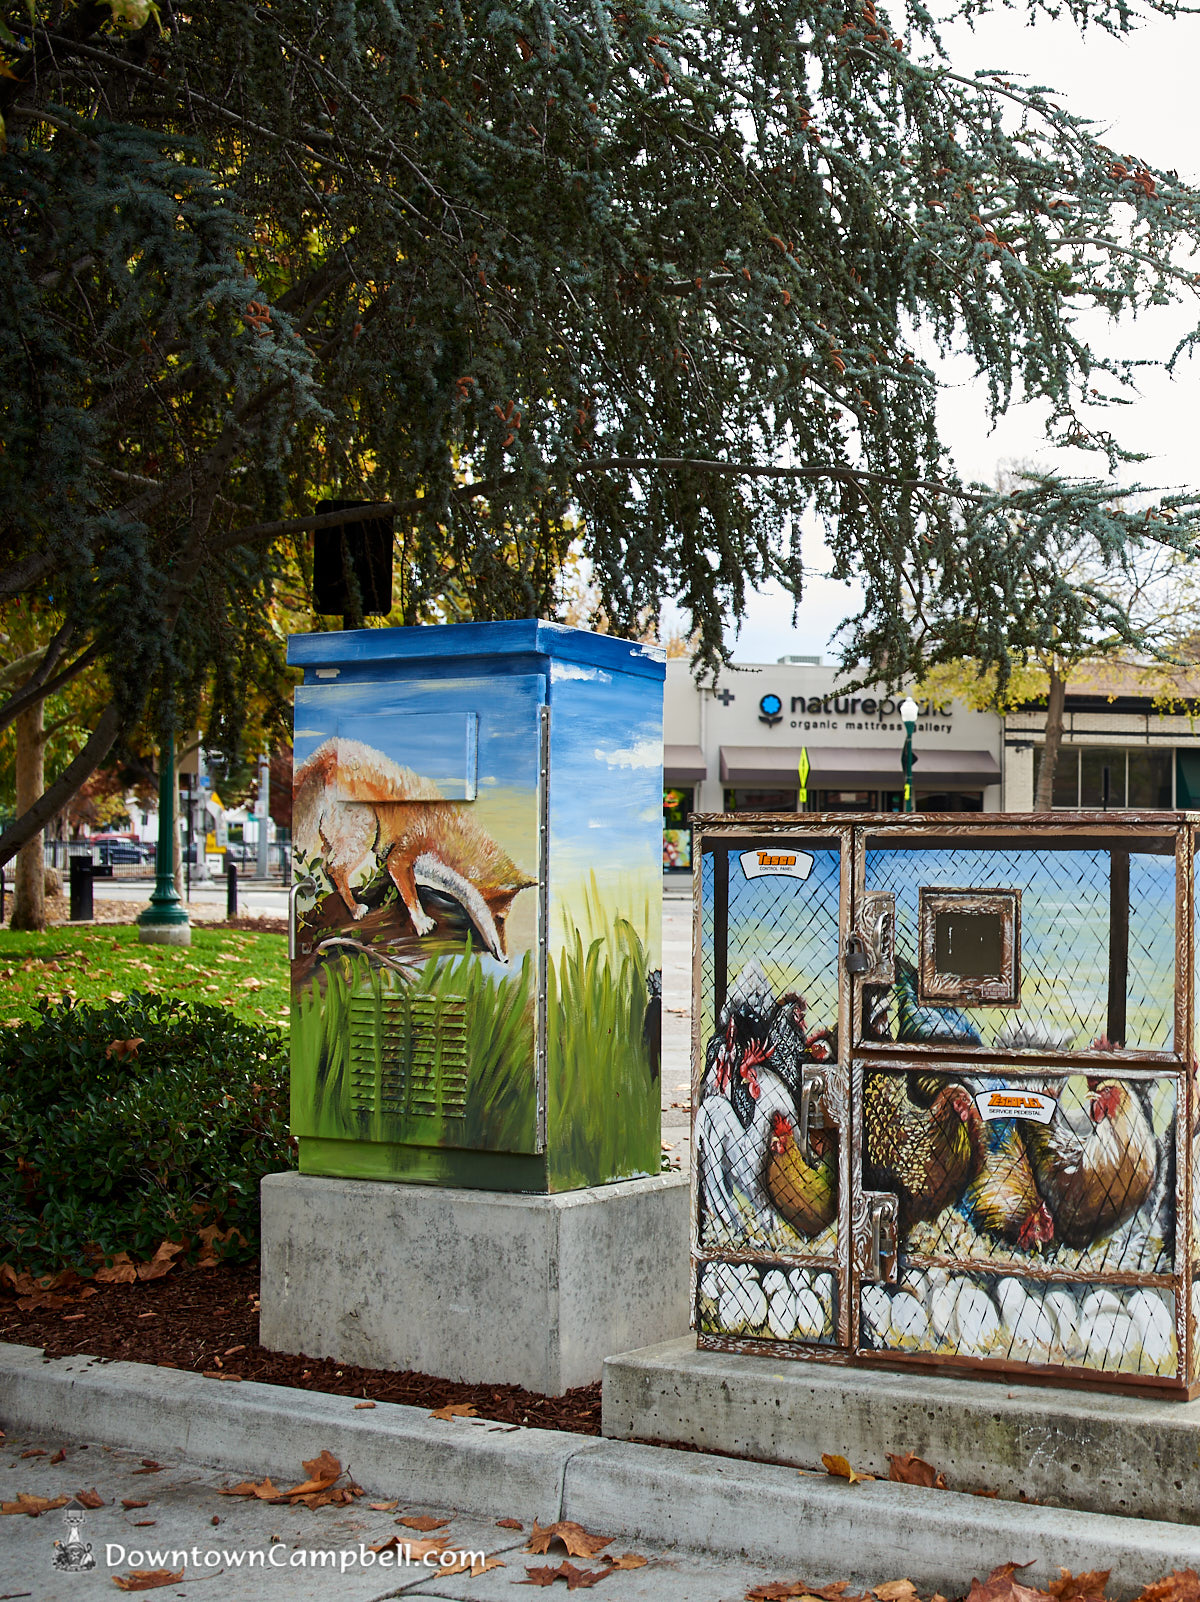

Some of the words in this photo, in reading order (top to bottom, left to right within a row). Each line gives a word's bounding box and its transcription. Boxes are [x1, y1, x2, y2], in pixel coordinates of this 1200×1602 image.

[790, 719, 838, 731] organic
[846, 720, 902, 731] mattress
[988, 1092, 1045, 1109] TESCOFLEX
